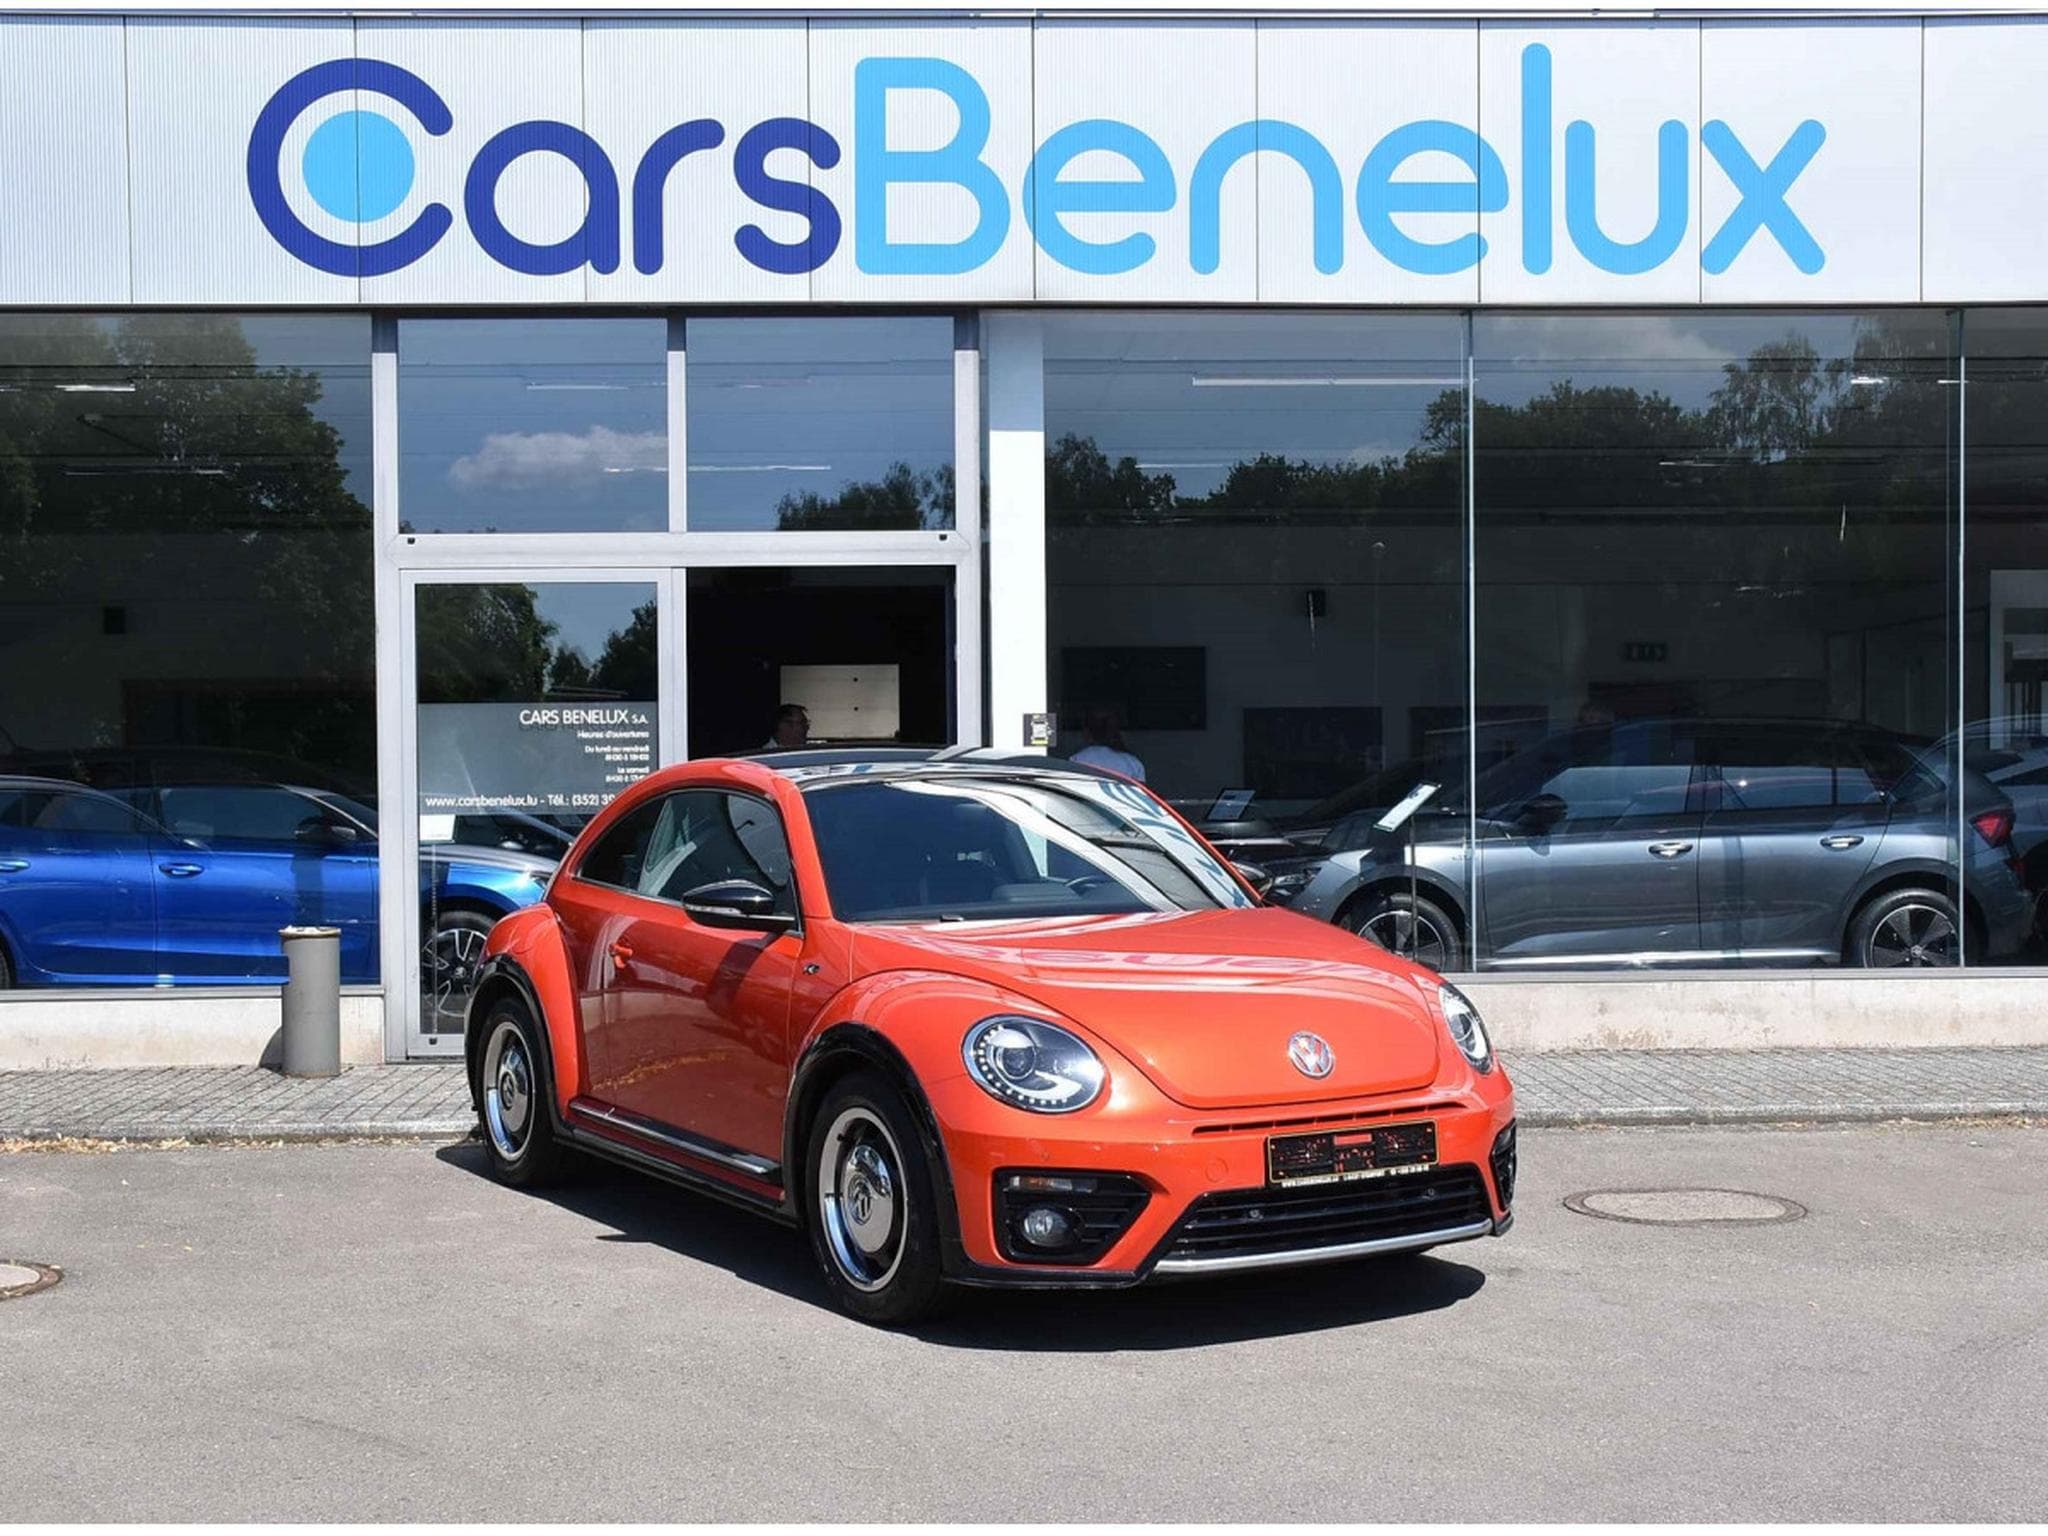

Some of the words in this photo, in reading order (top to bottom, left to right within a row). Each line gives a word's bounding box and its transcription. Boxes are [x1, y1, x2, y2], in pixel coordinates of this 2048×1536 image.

[519, 709, 560, 725] CARS
[562, 709, 629, 725] BENELUX
[425, 794, 538, 807] www.carsbenelux.lu
[572, 794, 599, 807] (352)
